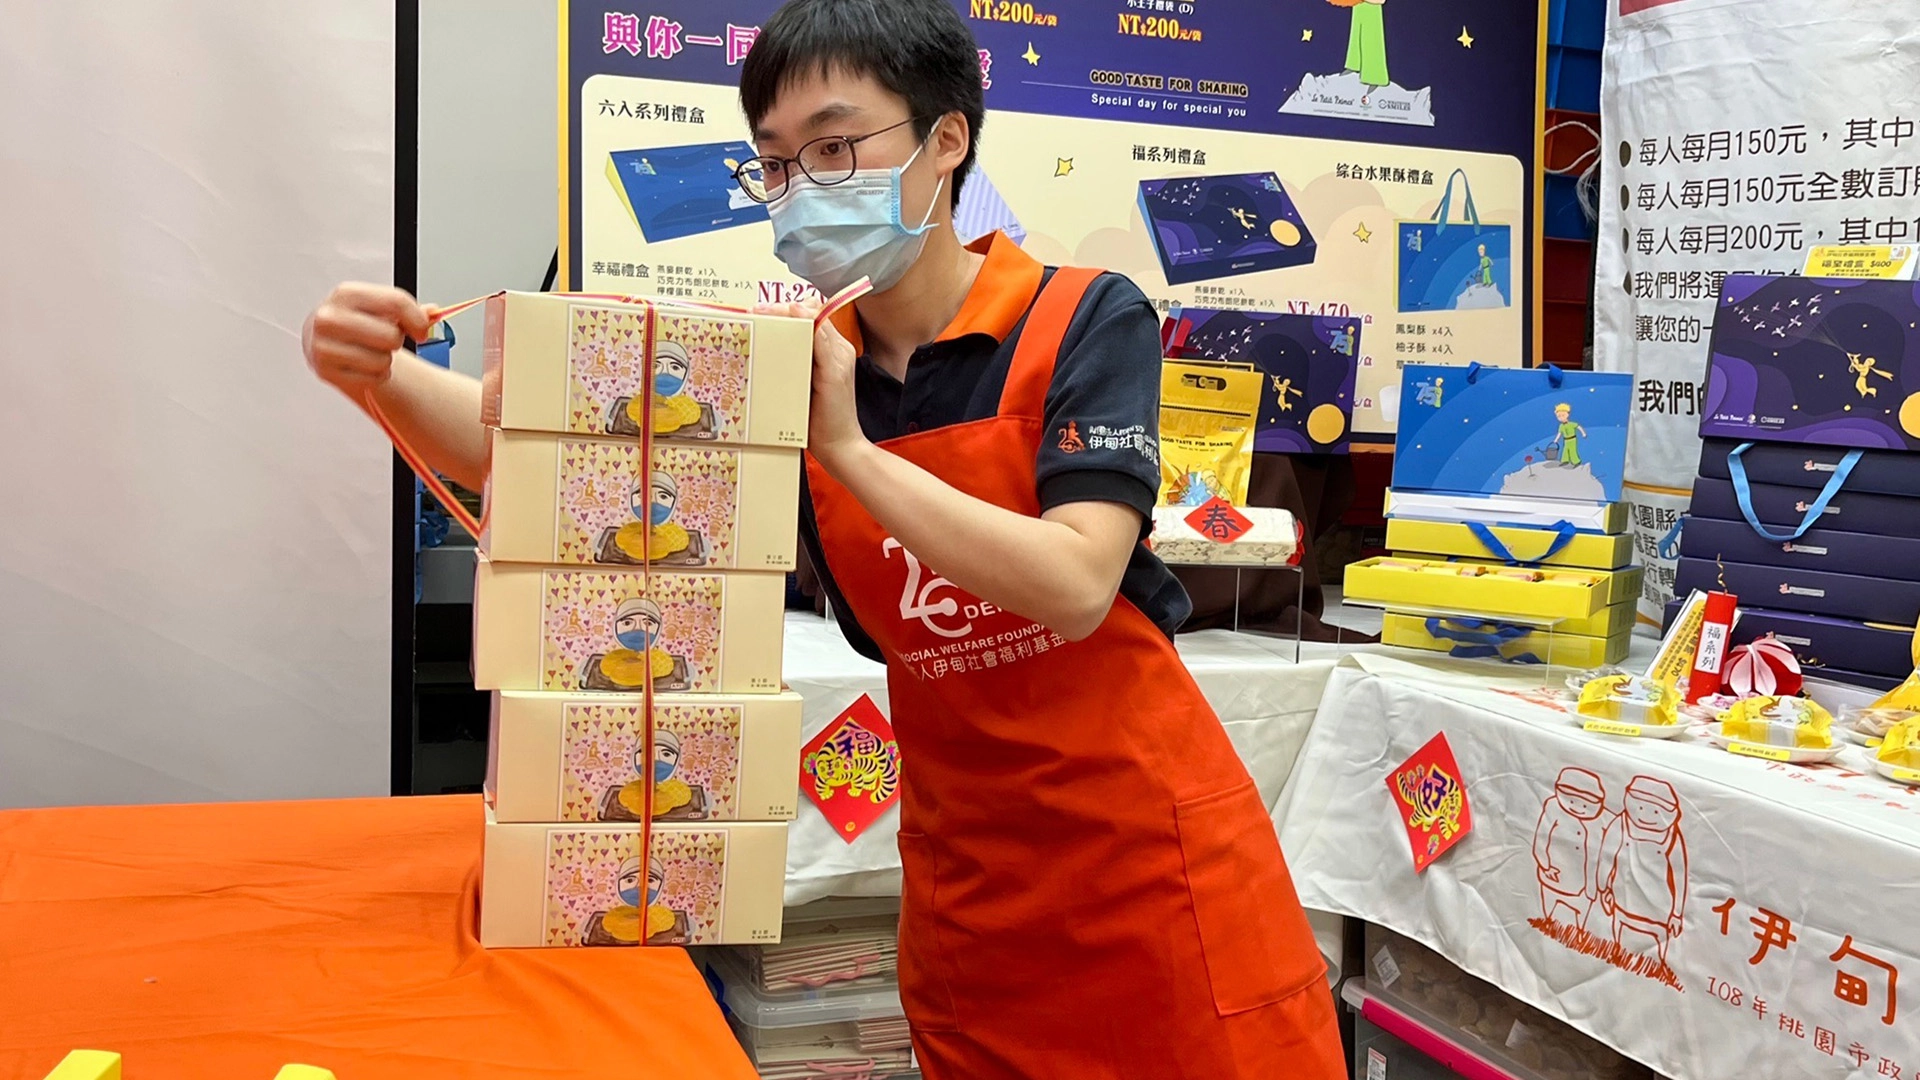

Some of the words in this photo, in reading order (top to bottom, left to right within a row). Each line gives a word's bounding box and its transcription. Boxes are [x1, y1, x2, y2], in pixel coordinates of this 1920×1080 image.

[1178, 3, 1194, 15] (D)
[1090, 69, 1122, 85] GOOD
[1126, 72, 1162, 89] TASTE
[1168, 78, 1192, 92] FOR
[1198, 81, 1248, 97] SHARING
[599, 99, 705, 124] 六入系列禮盒
[1091, 93, 1132, 107] Special
[1137, 99, 1157, 111] day
[1163, 100, 1178, 110] for
[1184, 102, 1222, 116] special
[1228, 107, 1247, 118] you
[1132, 144, 1206, 165] 福系列禮盒
[1335, 163, 1434, 185] 綜合水果酥禮盒
[592, 261, 650, 278] 幸福禮盒
[1202, 504, 1242, 538] 春
[940, 636, 996, 656] WELFARE
[1701, 625, 1721, 671] 福系列
[836, 731, 875, 759] 福
[1712, 898, 1898, 1025] 伊甸
[1706, 976, 1920, 1080] 108年桃園市政
